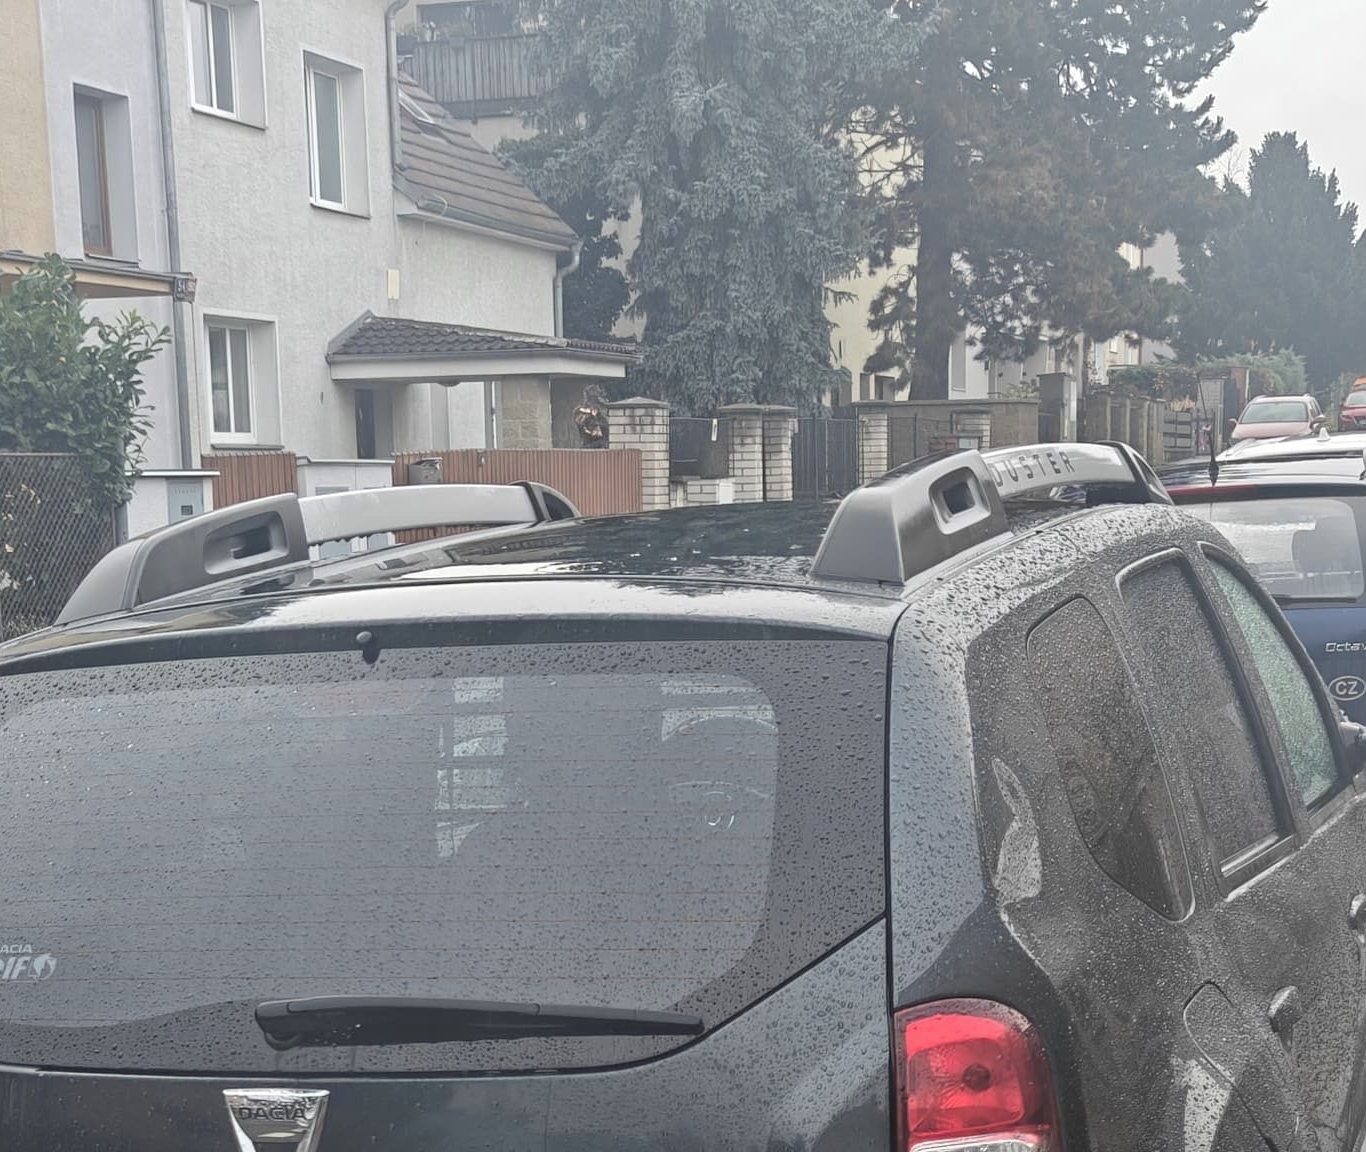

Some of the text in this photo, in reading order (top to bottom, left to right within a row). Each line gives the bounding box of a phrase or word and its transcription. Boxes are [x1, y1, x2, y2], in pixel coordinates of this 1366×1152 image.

[987, 451, 1075, 487] DUSTER
[1335, 681, 1358, 695] CZ
[237, 1106, 308, 1121] DACIA
